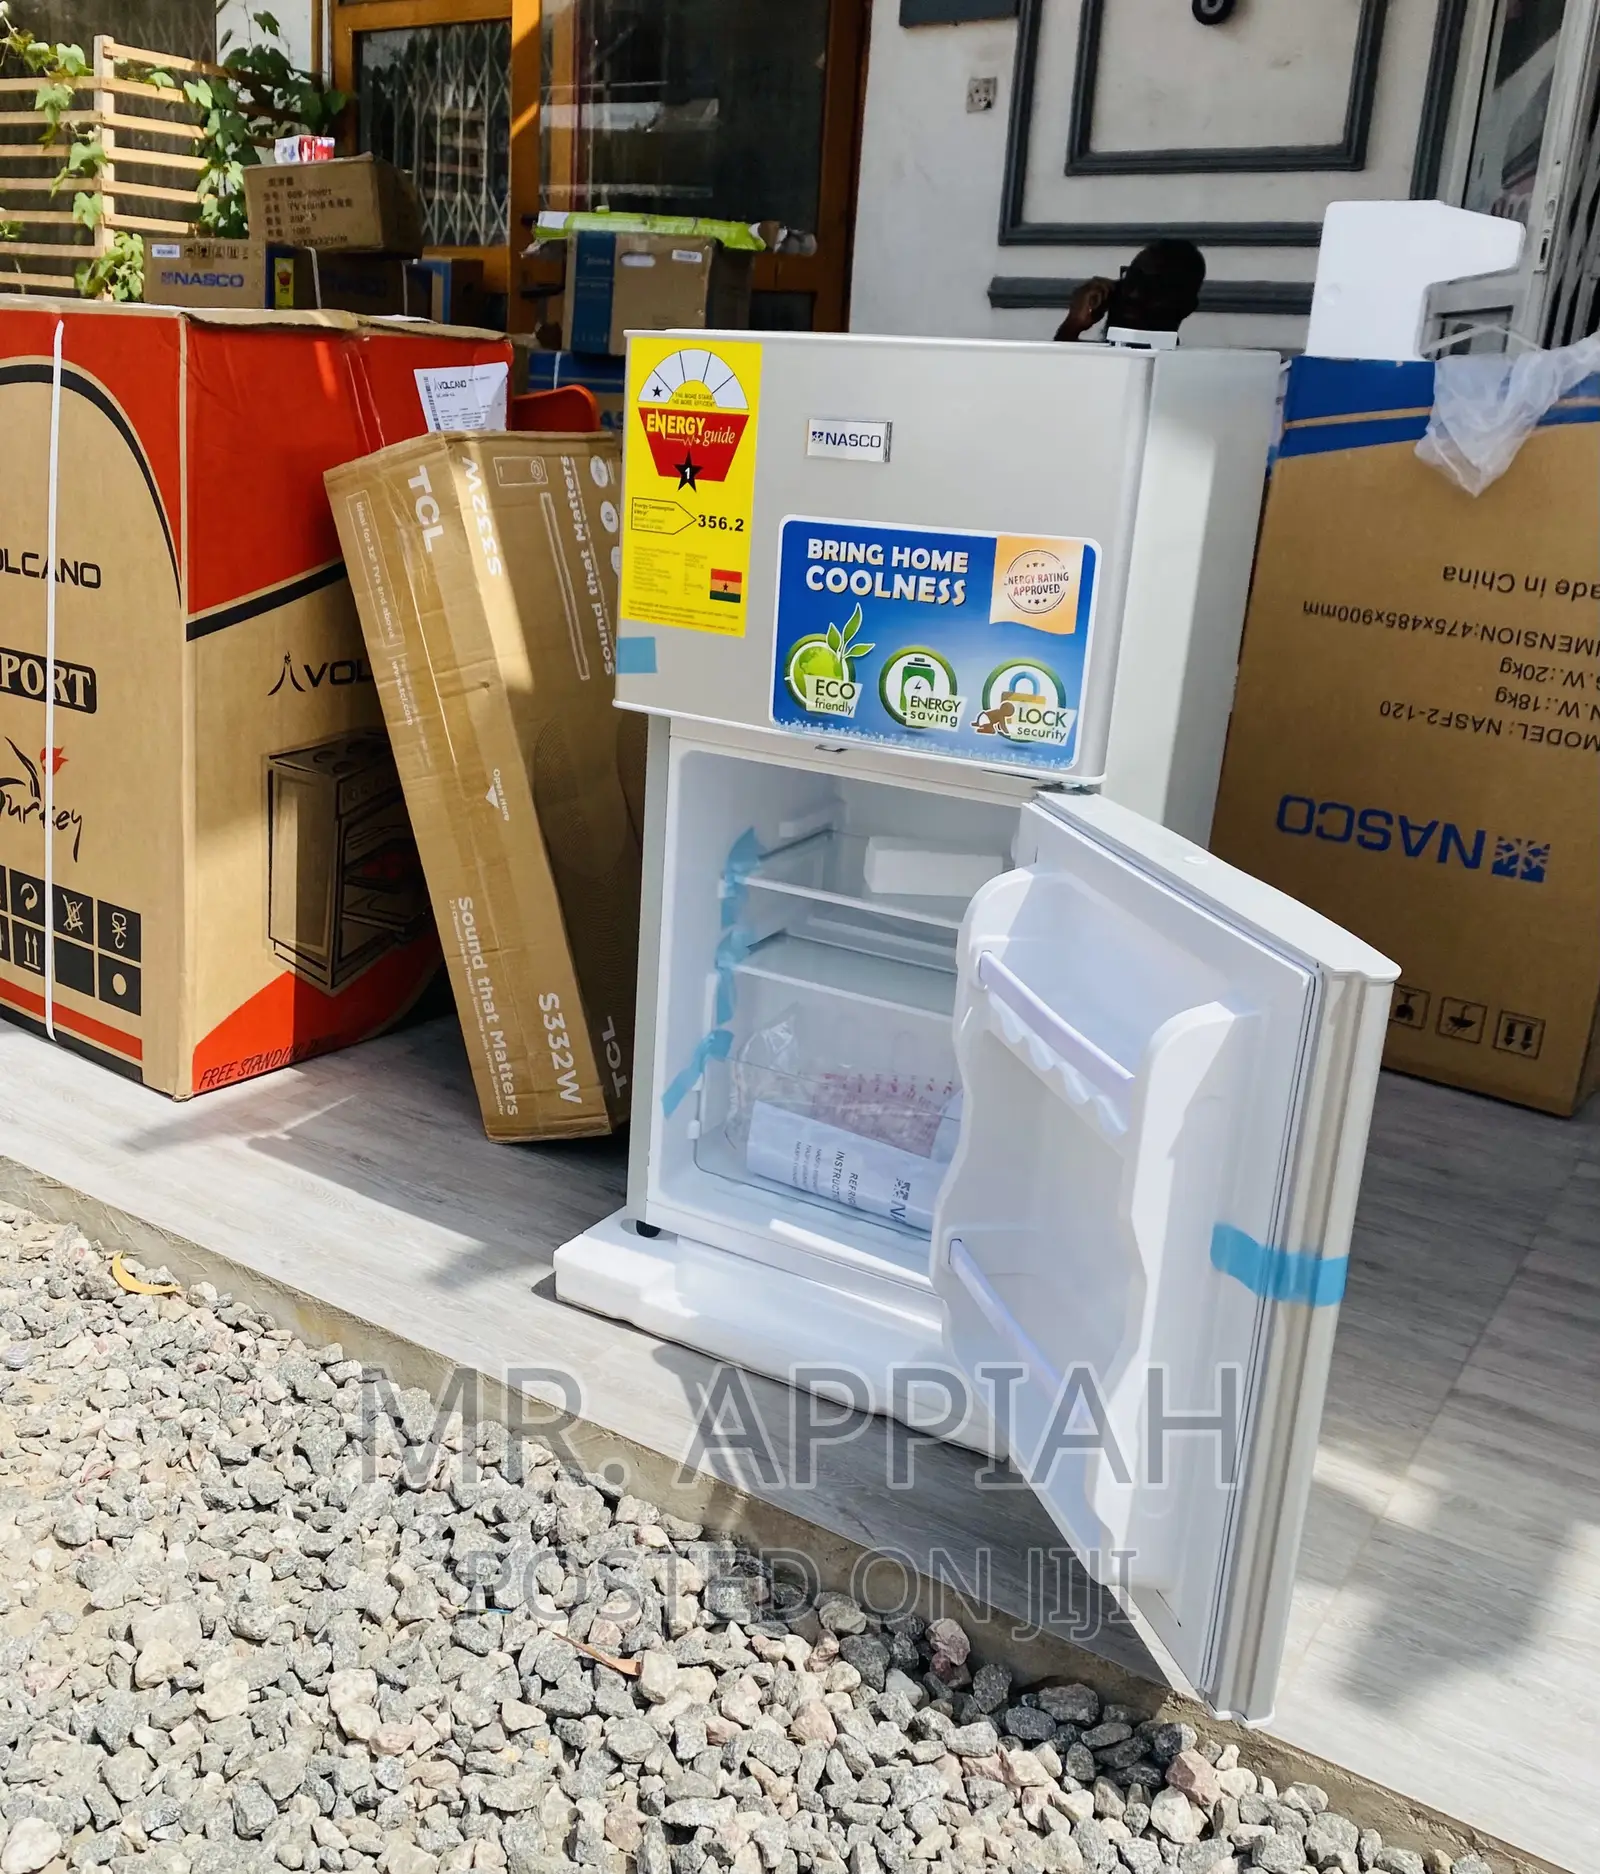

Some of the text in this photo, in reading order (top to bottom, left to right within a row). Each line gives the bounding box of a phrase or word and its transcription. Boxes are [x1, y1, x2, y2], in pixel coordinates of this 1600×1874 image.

[175, 272, 244, 288] NASCO
[439, 379, 467, 390] VOLCANO
[647, 409, 706, 440] ENERGY
[702, 426, 735, 447] guide
[825, 432, 881, 449] NASCO
[684, 467, 691, 480] 1
[408, 465, 444, 553] TCL
[560, 455, 586, 542] Matters
[697, 514, 745, 532] 356.2
[0, 548, 101, 588] LCANO
[807, 538, 969, 573] BRING HOME
[580, 550, 598, 596] that
[805, 565, 968, 607] COOLNESS
[1037, 572, 1069, 583] RATING
[1442, 565, 1516, 594] China
[1524, 576, 1548, 598] in
[1013, 583, 1061, 596] APPROVED
[0, 652, 92, 708] PORT
[815, 679, 855, 700] ECO
[815, 699, 854, 716] friendly
[910, 695, 962, 713] ENERGY
[910, 710, 958, 727] saving
[1018, 707, 1068, 728] LOCK
[1380, 700, 1502, 736] NASF2-120
[1017, 726, 1067, 742] security
[1276, 794, 1487, 870] NASCO
[458, 896, 519, 1116] Sound that Matters
[538, 991, 582, 1105] S332W
[602, 1016, 628, 1098] TCL
[199, 1060, 238, 1089] FREE
